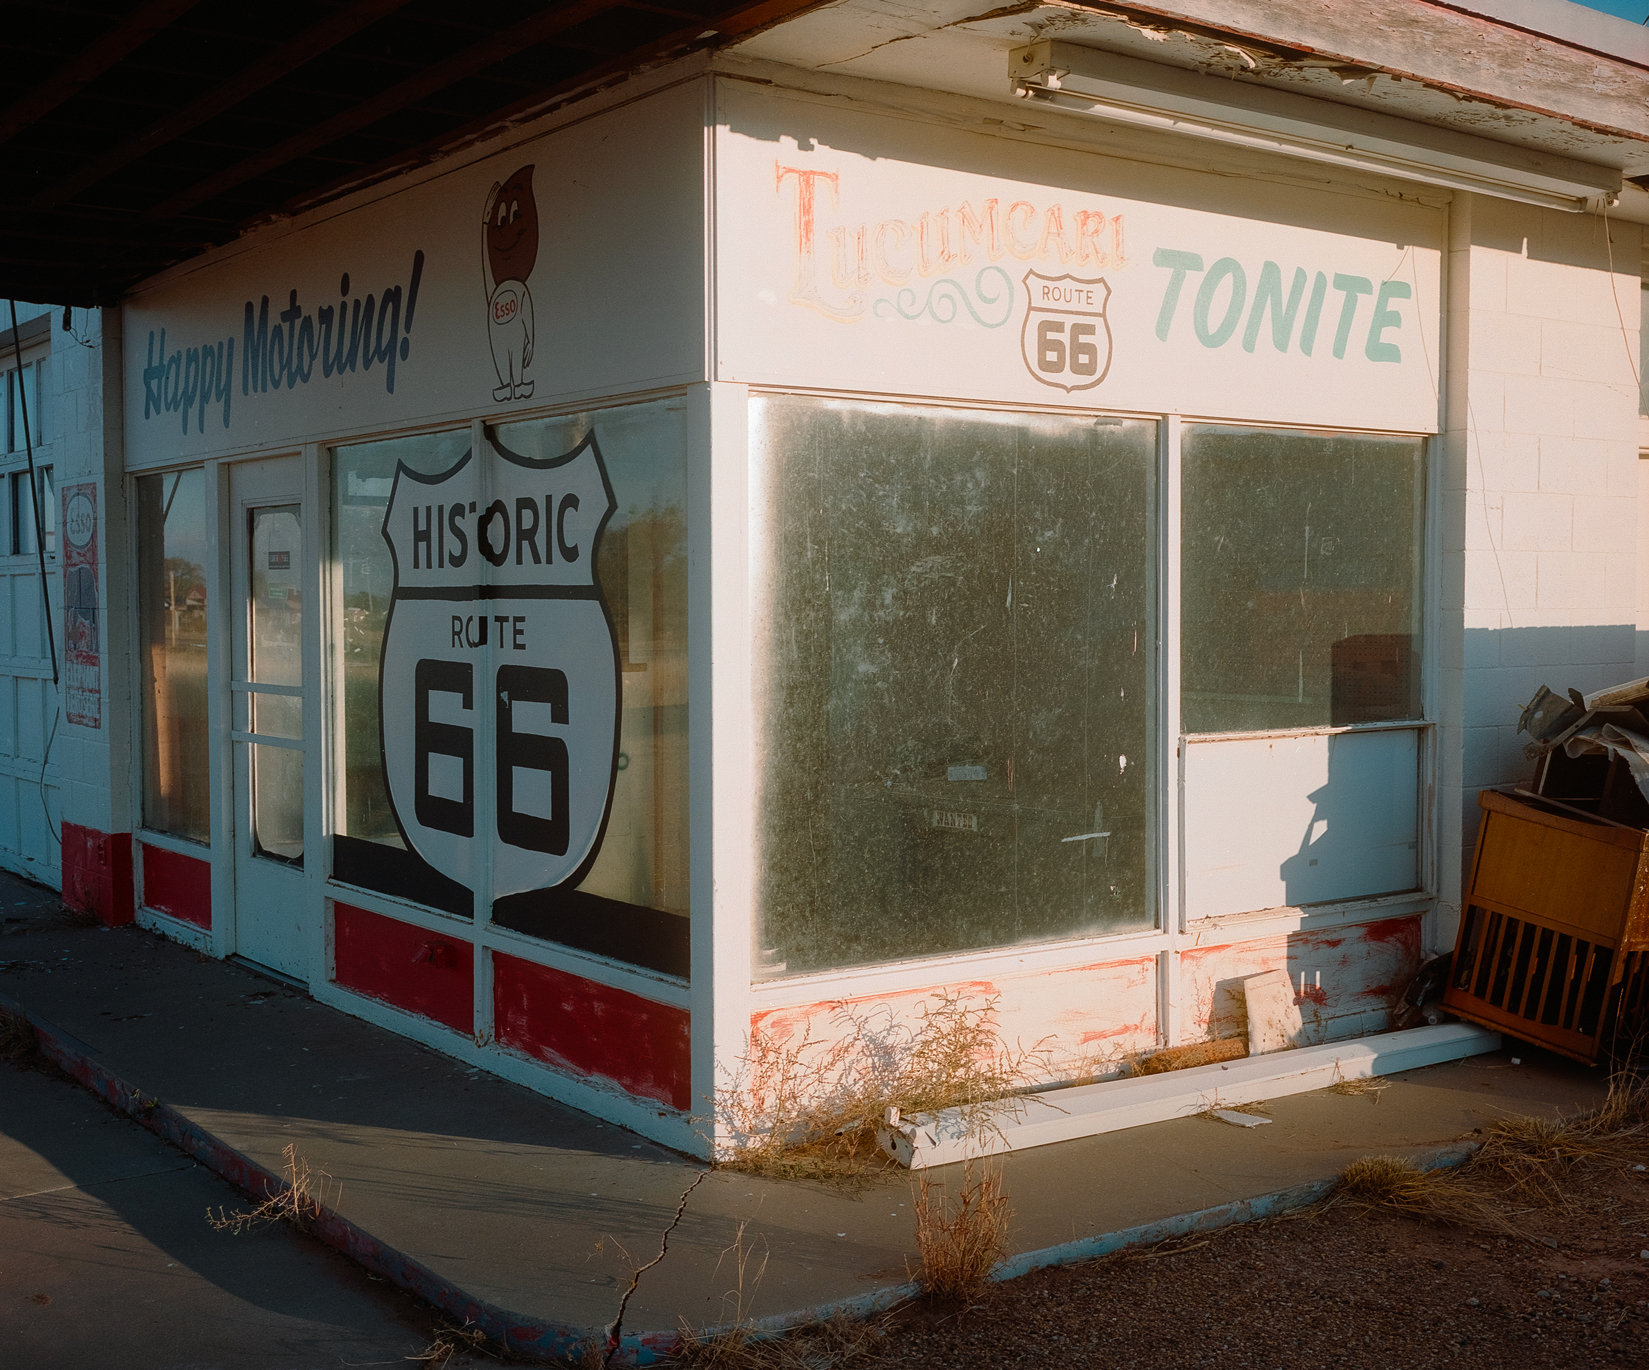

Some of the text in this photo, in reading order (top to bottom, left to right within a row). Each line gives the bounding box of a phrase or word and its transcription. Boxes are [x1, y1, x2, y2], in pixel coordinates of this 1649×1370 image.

[1041, 285, 1095, 307] ROUTE
[1152, 247, 1412, 364] TONITE
[143, 250, 425, 435] Happy Motoring!
[1036, 322, 1098, 376] 66
[413, 493, 580, 569] HISORIC
[414, 658, 570, 856] 66
[936, 812, 973, 828] WANTED
